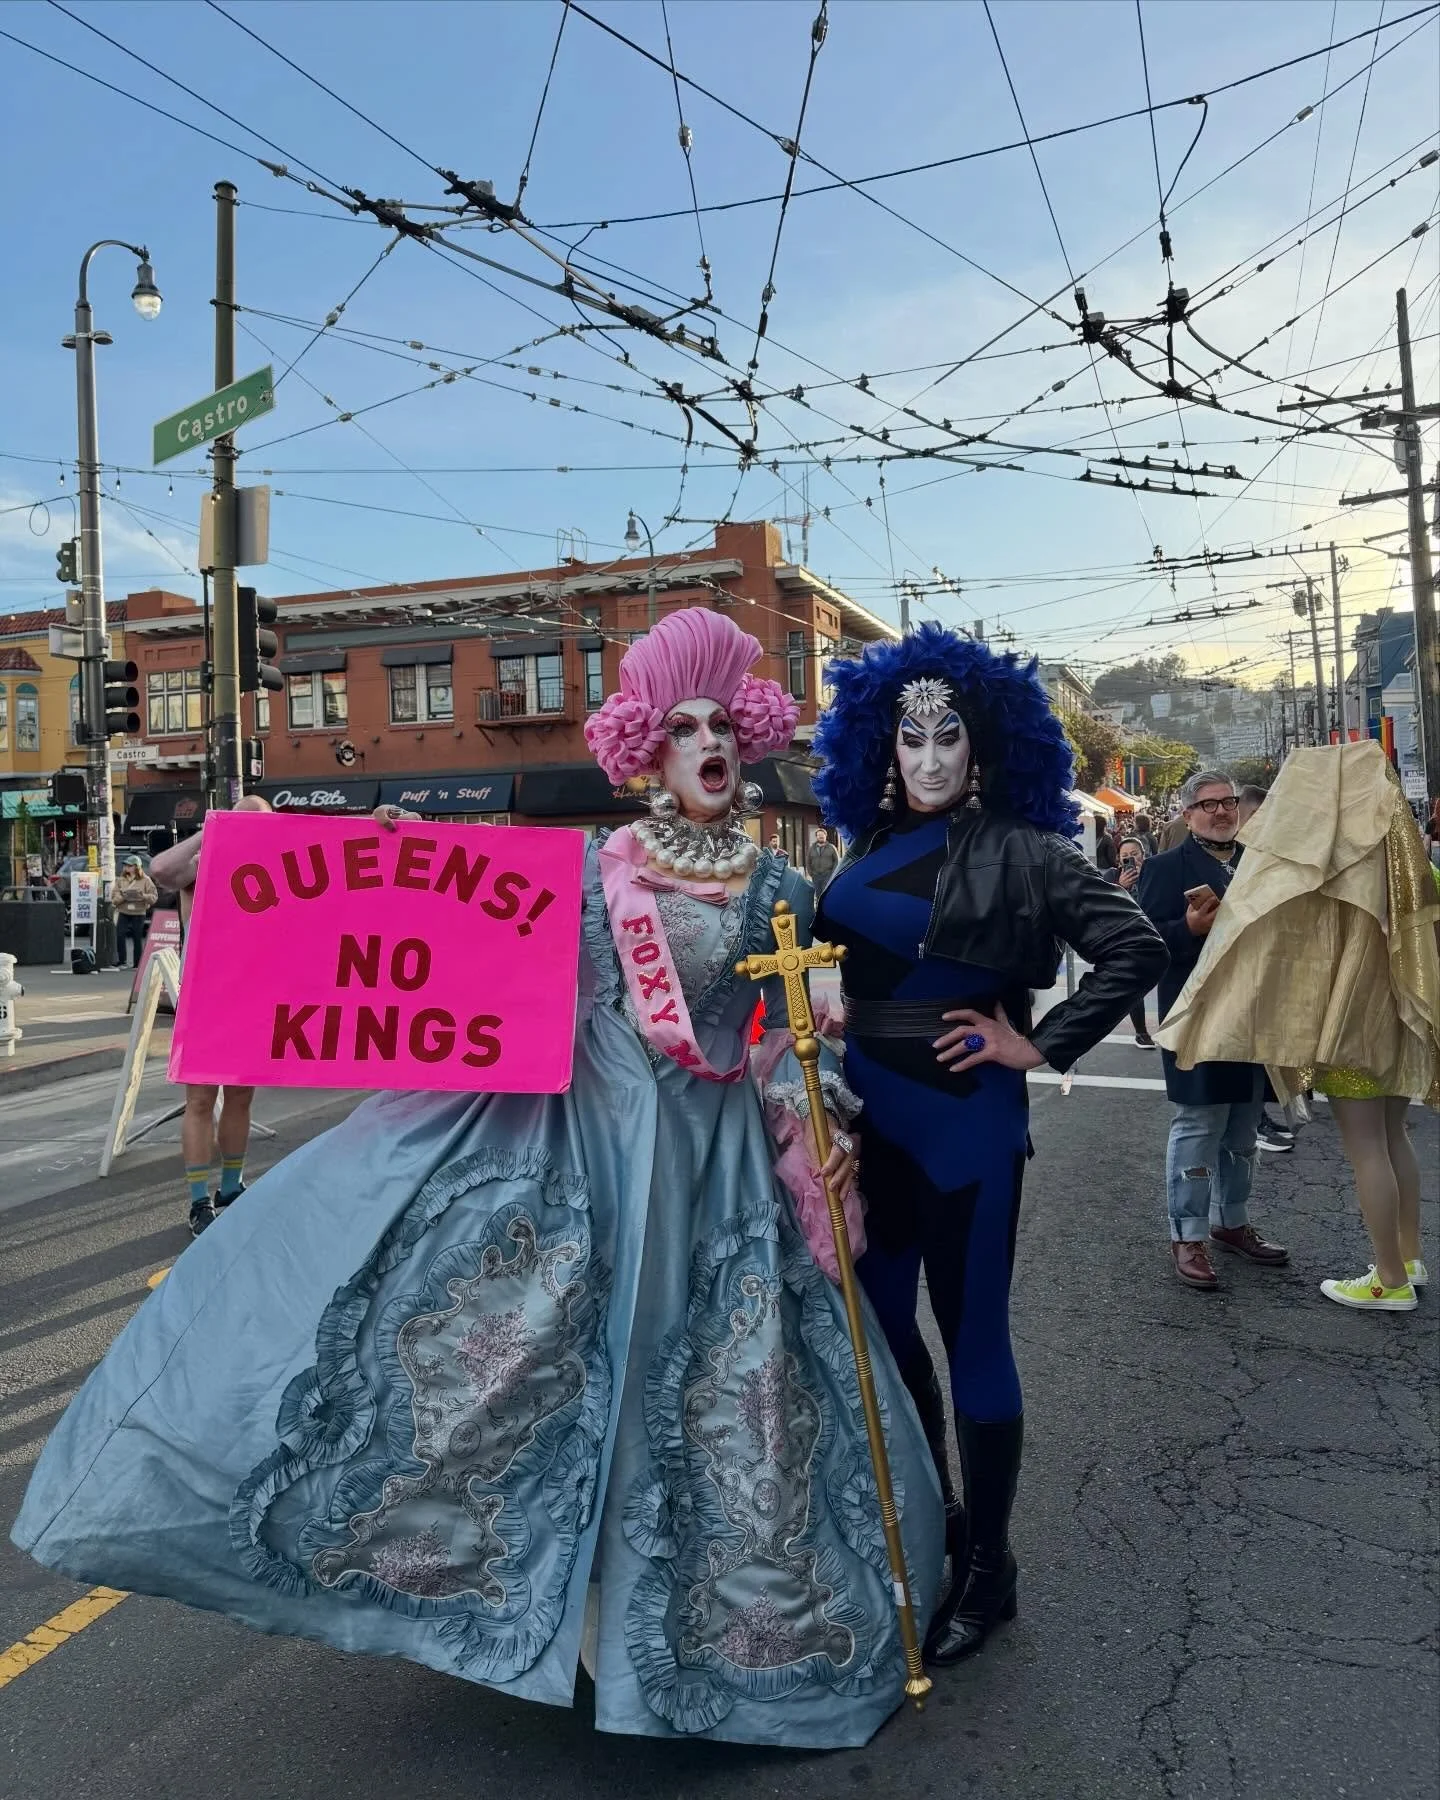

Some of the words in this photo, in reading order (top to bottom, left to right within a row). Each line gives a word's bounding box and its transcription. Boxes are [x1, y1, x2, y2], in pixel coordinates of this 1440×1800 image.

[177, 396, 247, 442] Castro
[117, 751, 146, 759] Castro
[272, 790, 309, 808] One
[309, 790, 348, 806] Bite
[456, 787, 492, 800] Stuff
[231, 837, 557, 937] QUEENS!
[335, 934, 432, 991] NO
[621, 914, 680, 1025] FOXY
[270, 1004, 504, 1068] KINGS
